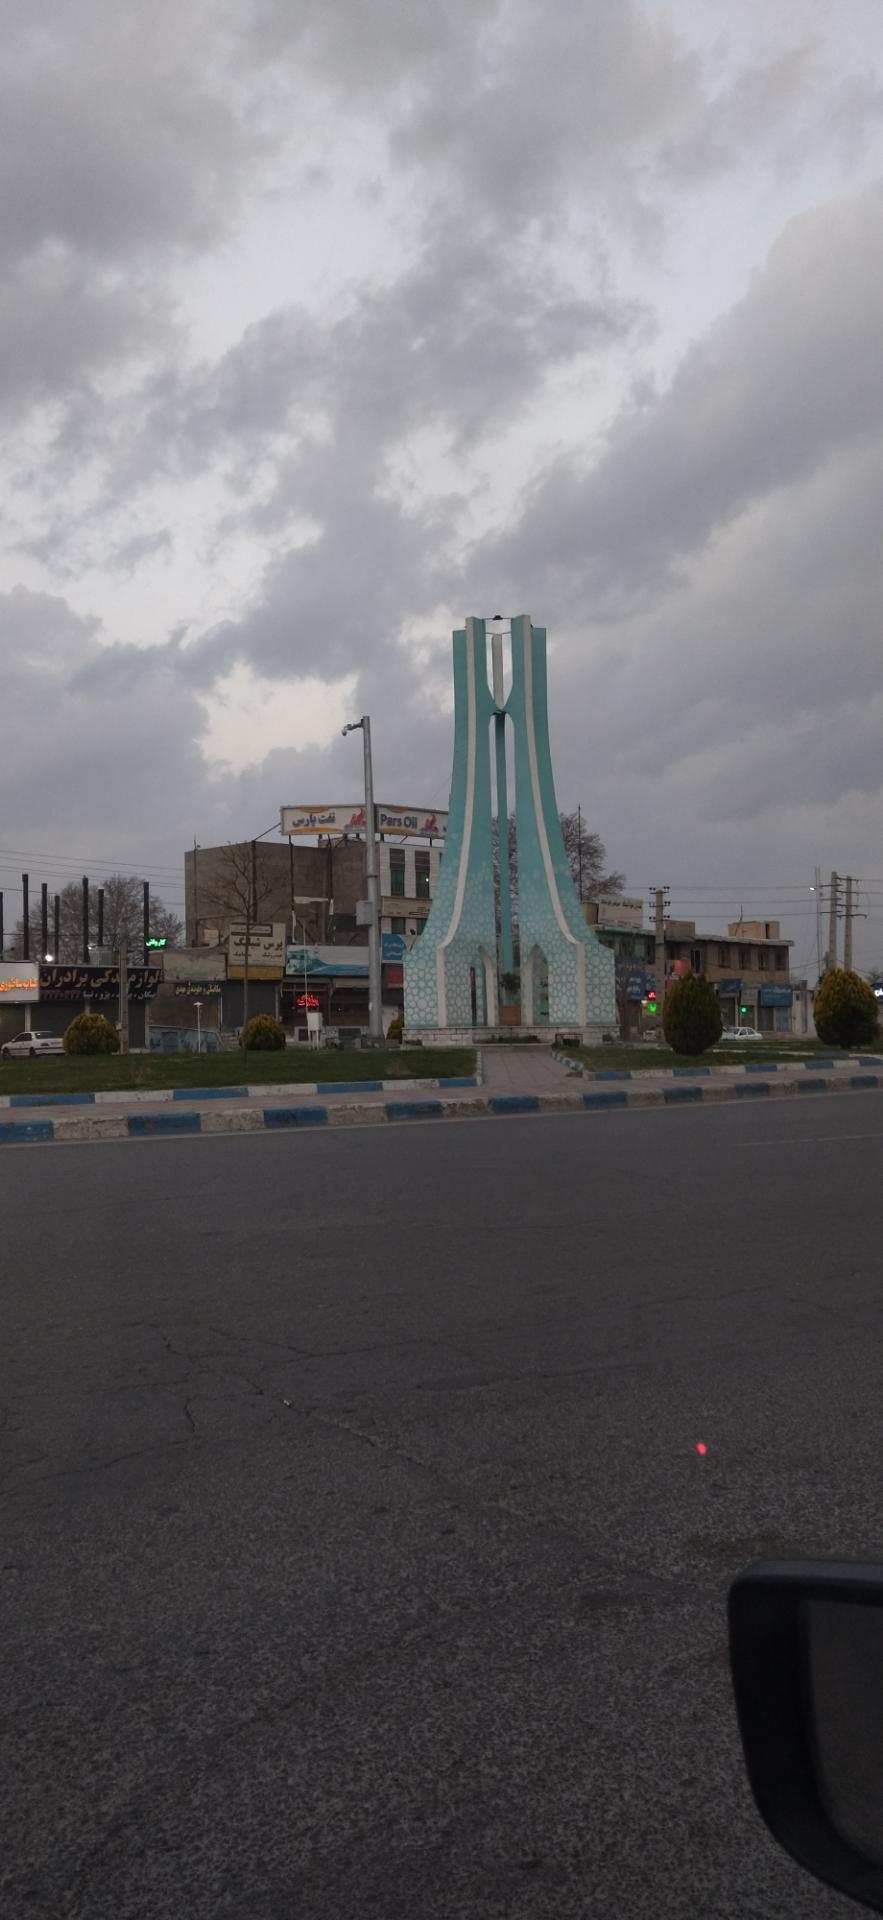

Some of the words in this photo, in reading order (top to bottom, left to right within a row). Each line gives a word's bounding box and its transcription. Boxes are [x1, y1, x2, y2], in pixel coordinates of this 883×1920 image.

[292, 814, 316, 828] پارس
[318, 813, 335, 825] نفت
[380, 814, 402, 826] Pars
[403, 816, 418, 829] Oil
[40, 968, 89, 988] برادران
[90, 969, 119, 988] دکی
[127, 969, 160, 988] لوازم
